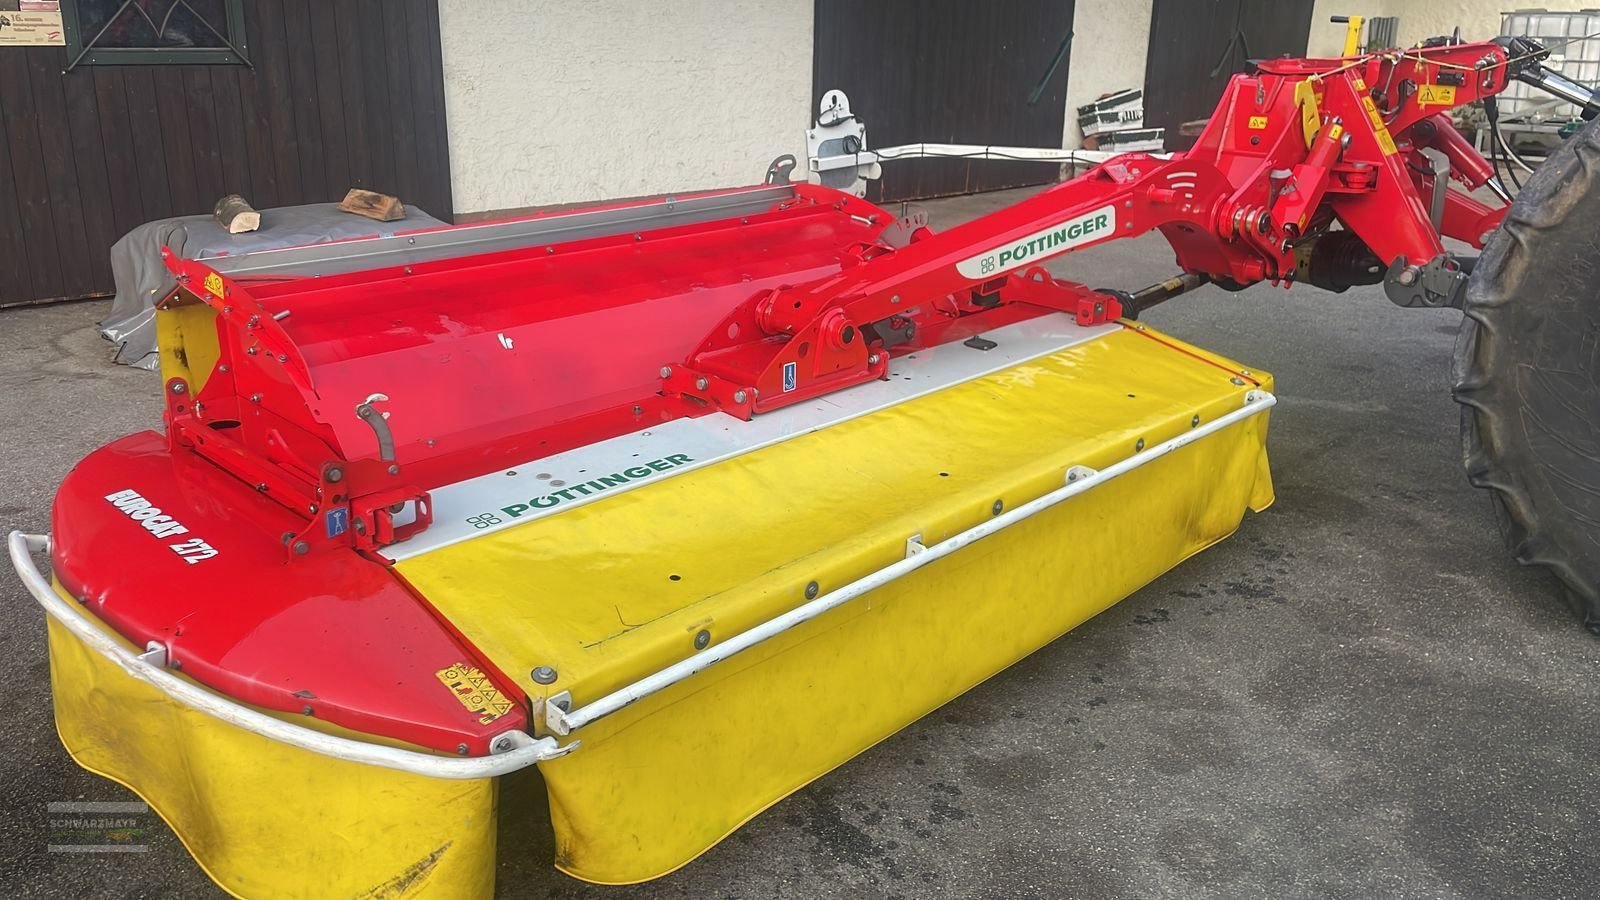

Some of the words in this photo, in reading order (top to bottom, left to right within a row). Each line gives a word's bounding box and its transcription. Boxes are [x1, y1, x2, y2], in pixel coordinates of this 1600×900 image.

[999, 214, 1107, 267] PÖTTINGER
[500, 453, 694, 518] PÖTTINGER
[104, 489, 189, 539] EUROCAT
[169, 538, 219, 565] 272
